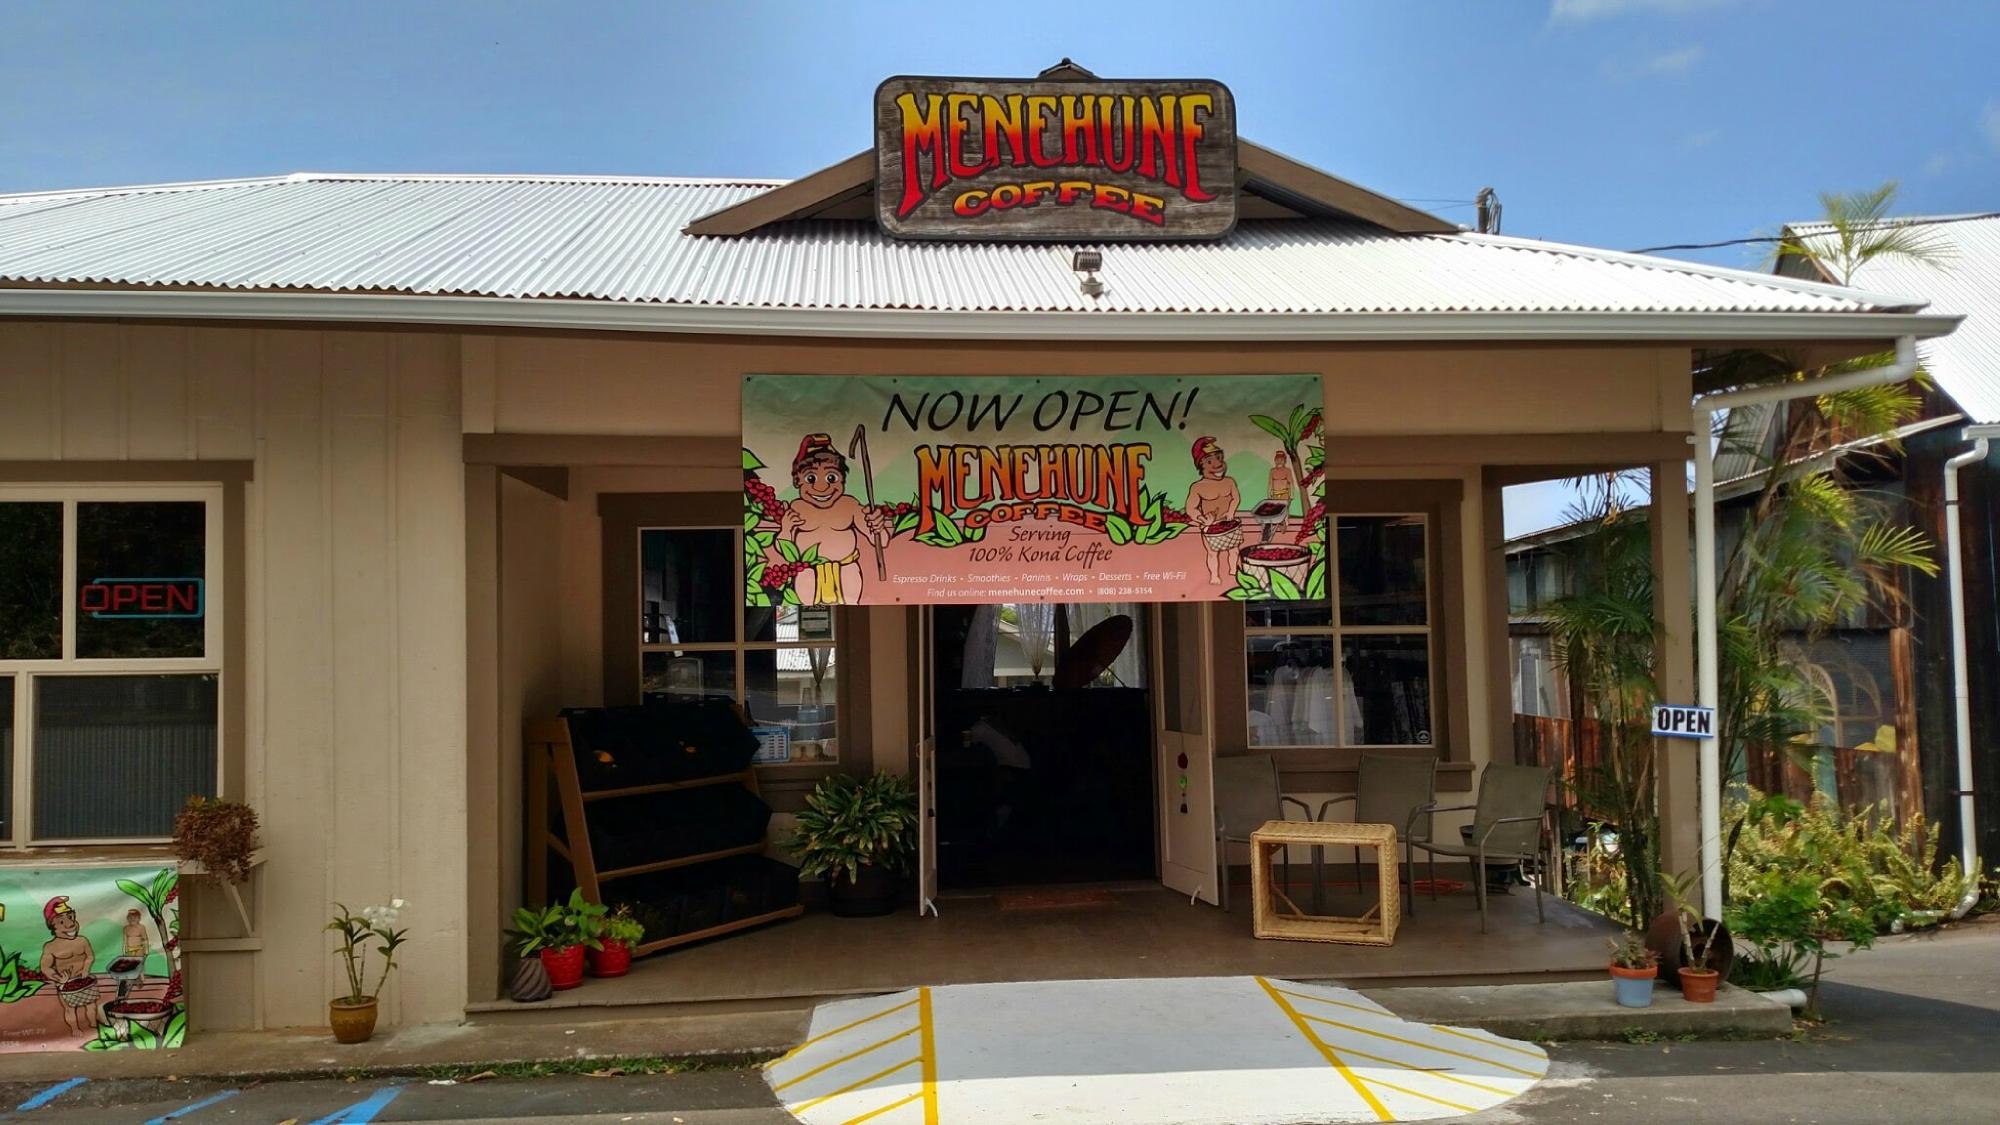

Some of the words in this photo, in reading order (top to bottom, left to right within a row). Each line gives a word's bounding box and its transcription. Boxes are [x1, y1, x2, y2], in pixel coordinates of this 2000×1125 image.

[895, 91, 1219, 218] MENEHUNE
[953, 180, 1166, 226] COFFEE
[881, 390, 1024, 432] NOW
[1033, 387, 1200, 431] OPEN!
[914, 443, 1153, 538] MENEHUNE
[964, 502, 1108, 535] COFFEE
[1008, 524, 1072, 549] Serving
[968, 546, 1013, 562] 100%
[1017, 546, 1061, 562] Kona
[1064, 542, 1114, 570] Coffee
[893, 574, 928, 584] Espresso
[929, 574, 957, 583] Drinks
[967, 573, 1011, 583] Smoothies
[1062, 572, 1088, 582] Wraps
[1098, 572, 1132, 581] Desserts
[1143, 571, 1161, 581] Free
[927, 588, 945, 597] Find
[947, 588, 958, 597] us
[988, 586, 1085, 597] menehunecoffee.com
[80, 584, 195, 611] OPEN
[1657, 708, 1711, 734] OPEN
